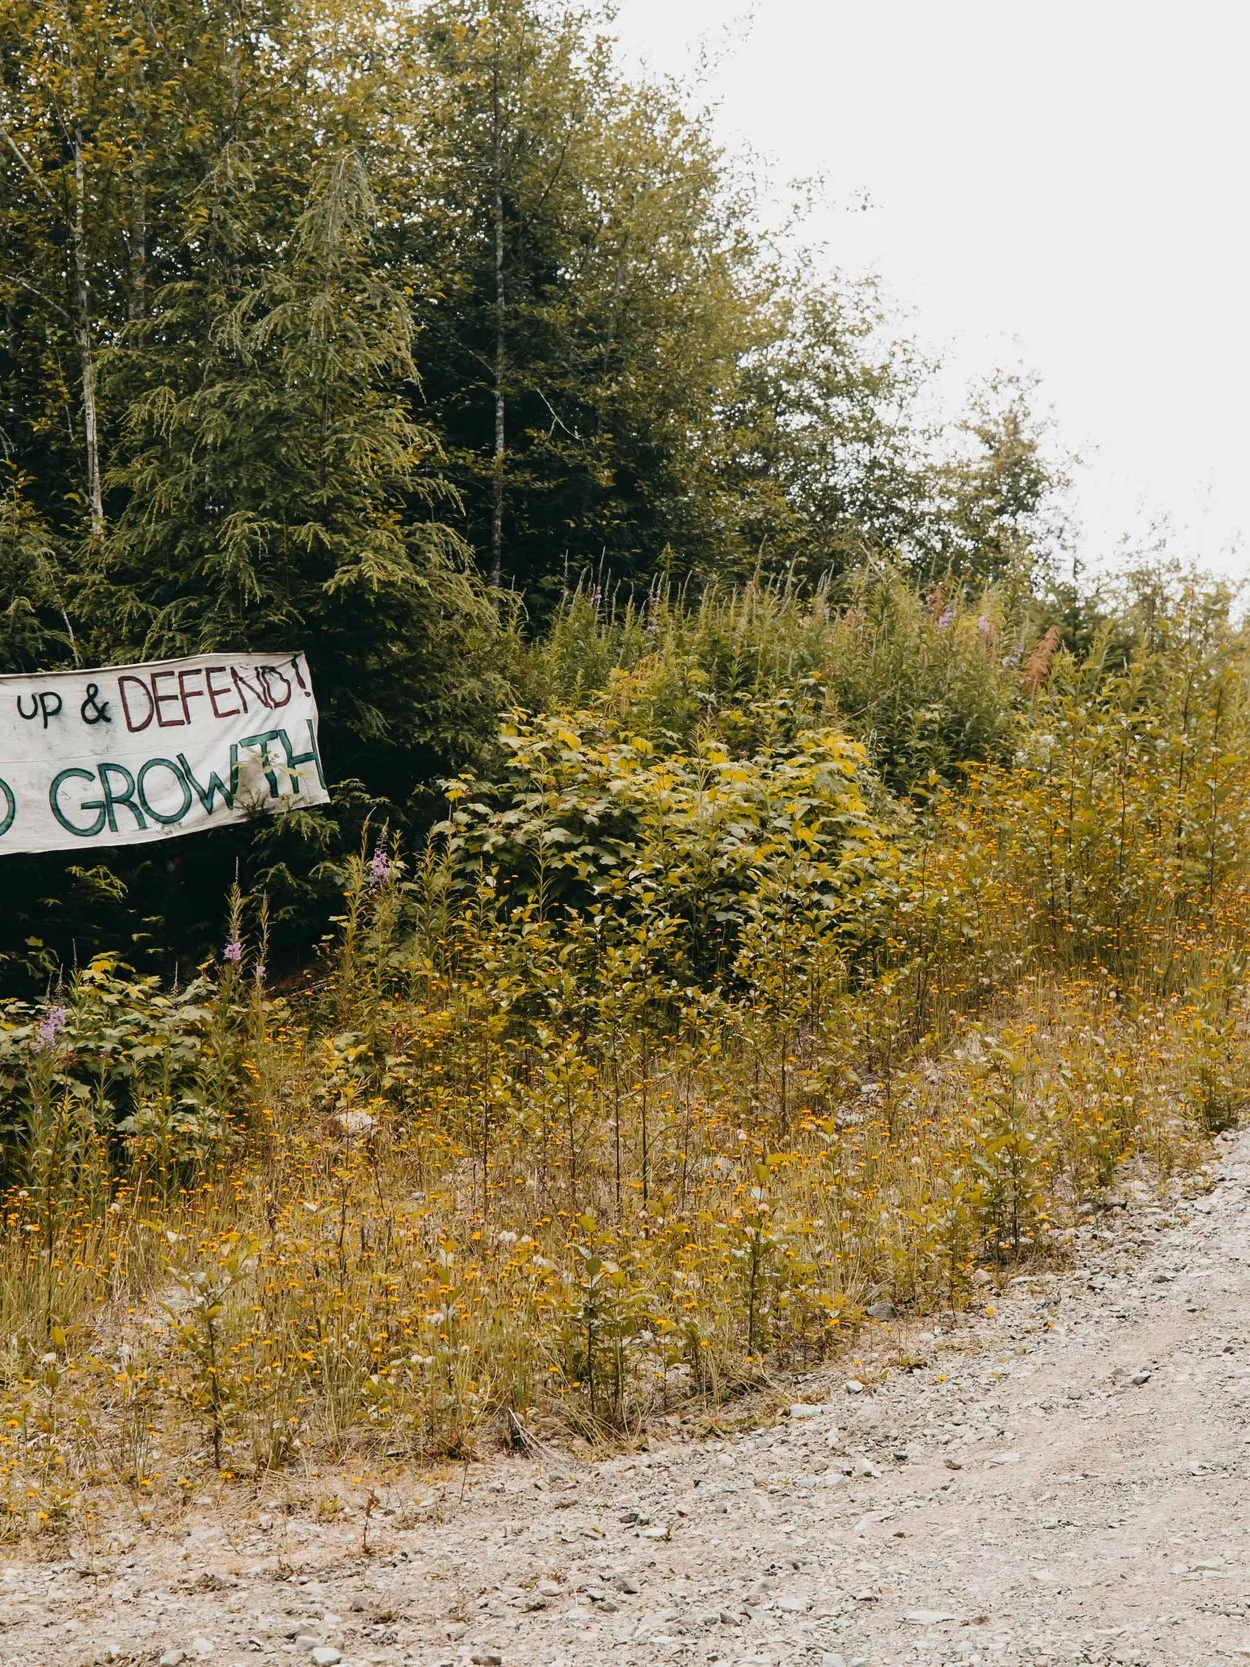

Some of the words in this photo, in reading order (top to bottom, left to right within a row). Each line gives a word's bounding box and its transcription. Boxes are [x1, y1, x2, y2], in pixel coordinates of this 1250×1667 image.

[17, 691, 62, 729] UP
[81, 683, 111, 724] &
[118, 660, 311, 732] DEFEND!
[49, 719, 326, 837] GROWTH
